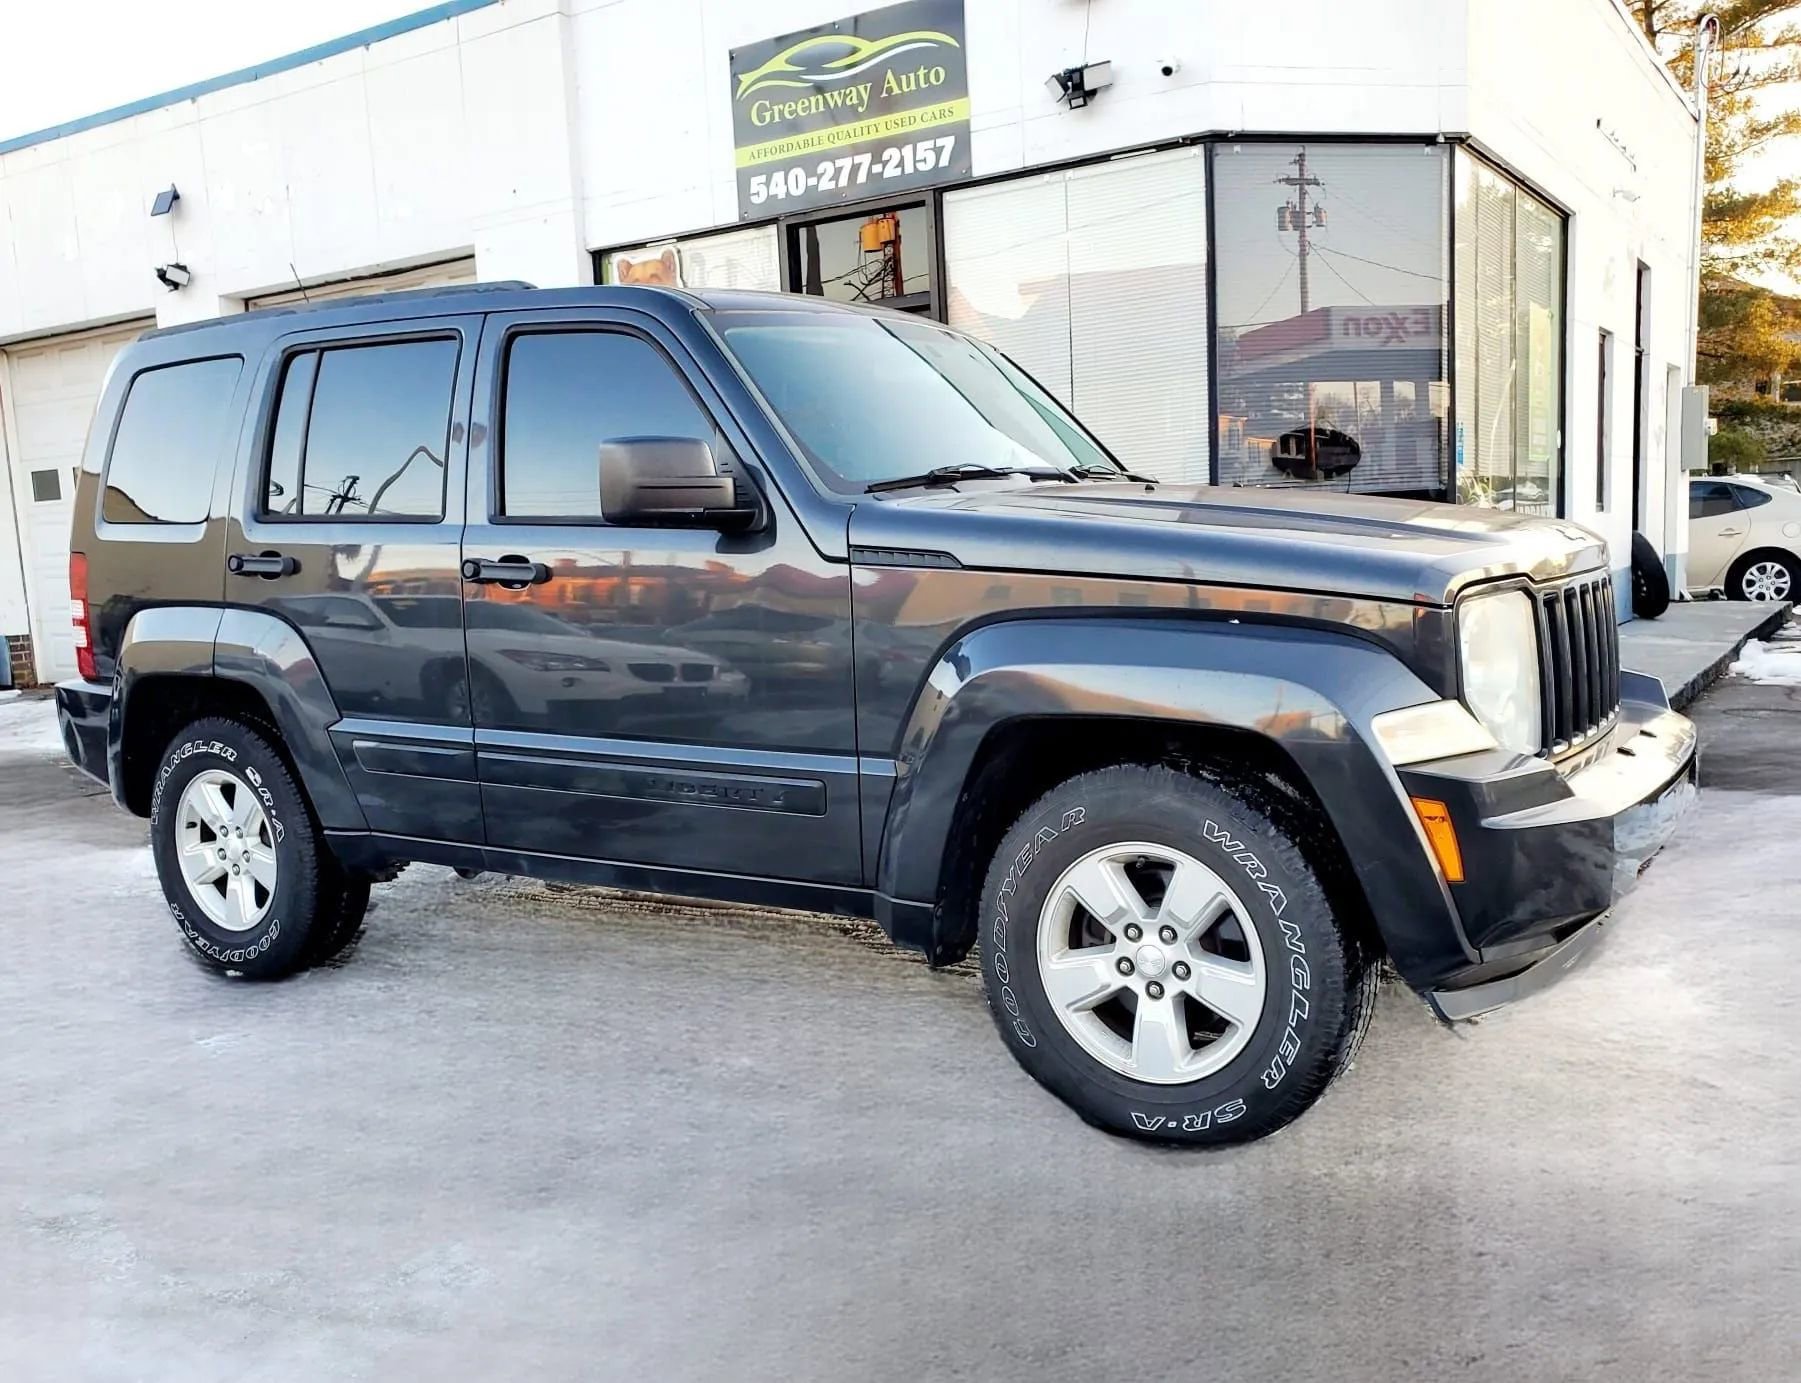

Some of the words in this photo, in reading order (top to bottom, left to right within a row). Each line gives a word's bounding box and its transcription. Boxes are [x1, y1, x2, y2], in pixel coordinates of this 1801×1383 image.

[751, 82, 872, 126] Greenway
[880, 64, 946, 98] Auto
[749, 135, 825, 161] AFFORDABLE
[827, 121, 881, 145] QUALITY
[885, 114, 917, 132] USED
[920, 106, 955, 124] CARS
[750, 135, 955, 204] 540-277-2157
[151, 740, 238, 825] WRANGLER
[649, 777, 786, 804] IBERT
[170, 902, 281, 962] GOODYEAR
[993, 806, 1087, 1049] GOODYEAR
[1202, 819, 1311, 1090] WRANGLER
